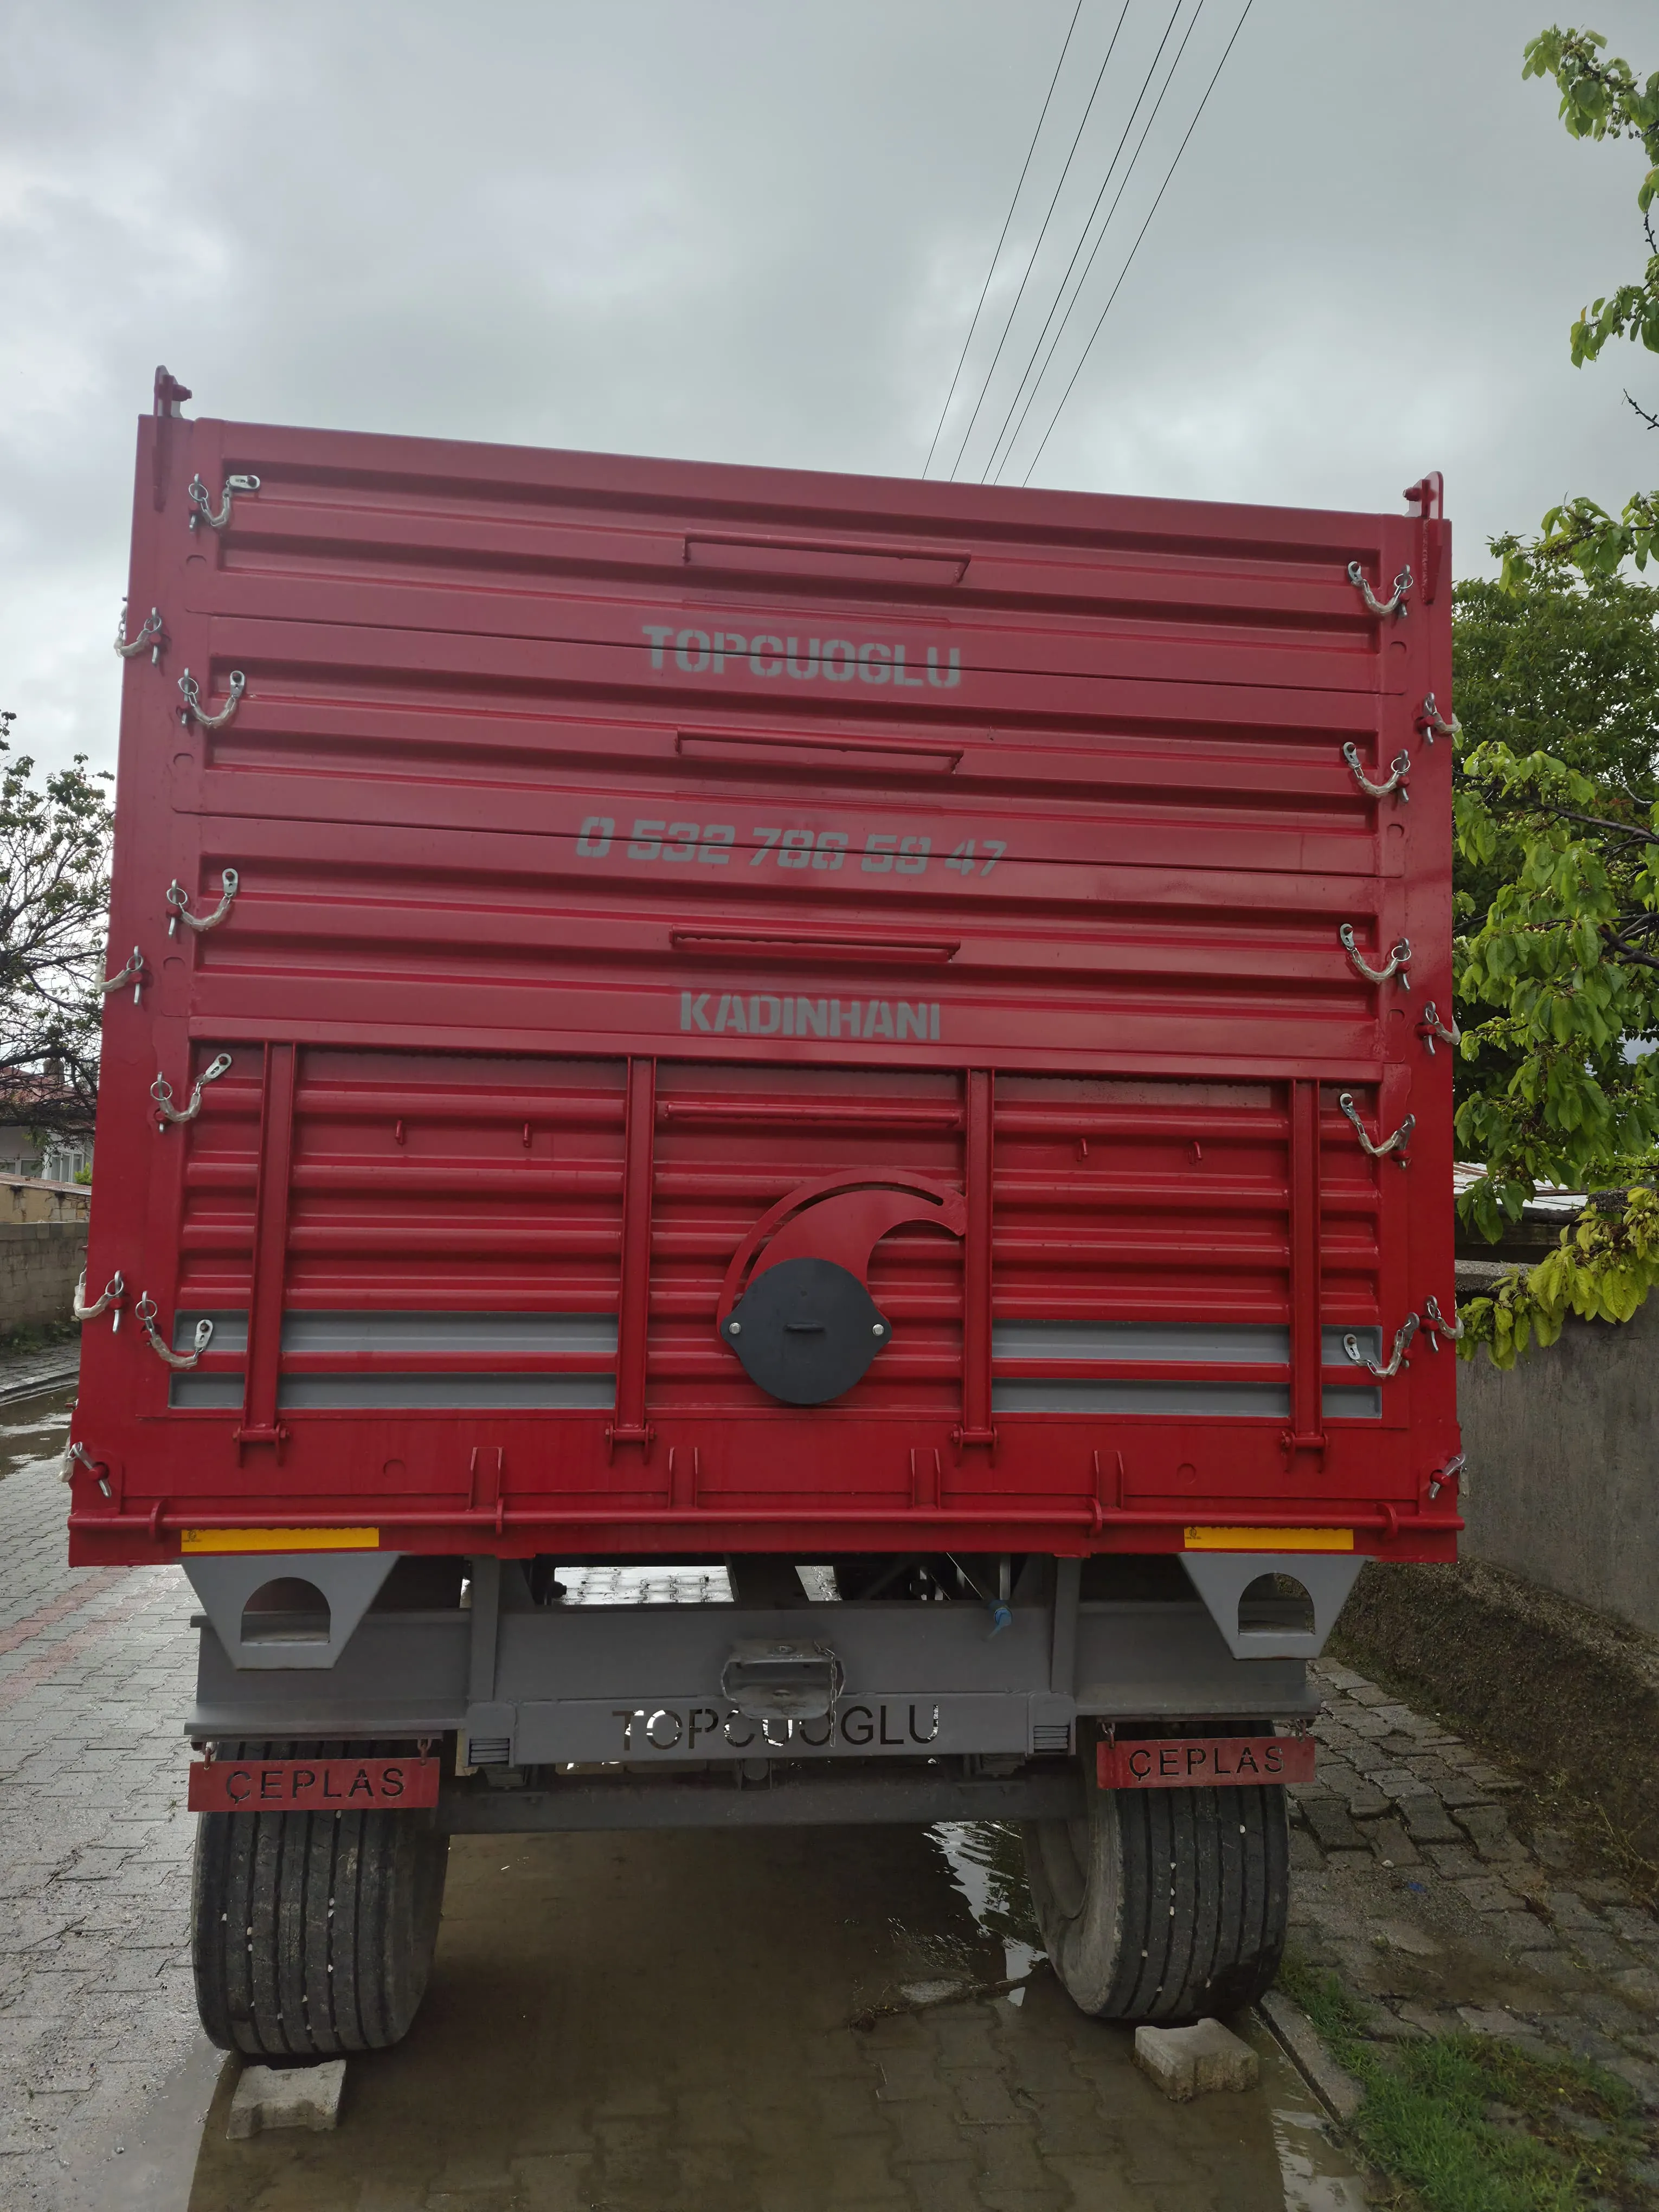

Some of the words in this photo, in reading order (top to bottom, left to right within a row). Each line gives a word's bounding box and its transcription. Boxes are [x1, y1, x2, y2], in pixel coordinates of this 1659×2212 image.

[642, 625, 961, 688] TOPCUOGLU
[576, 816, 615, 859] 0
[627, 819, 736, 865] 532
[749, 827, 848, 870] 786
[861, 834, 931, 874] 59
[944, 839, 1007, 877] 47
[680, 991, 941, 1040] KADINHANI
[226, 1767, 406, 1804] ÇEPLAS
[1129, 1746, 1284, 1782] ÇEPLAS
